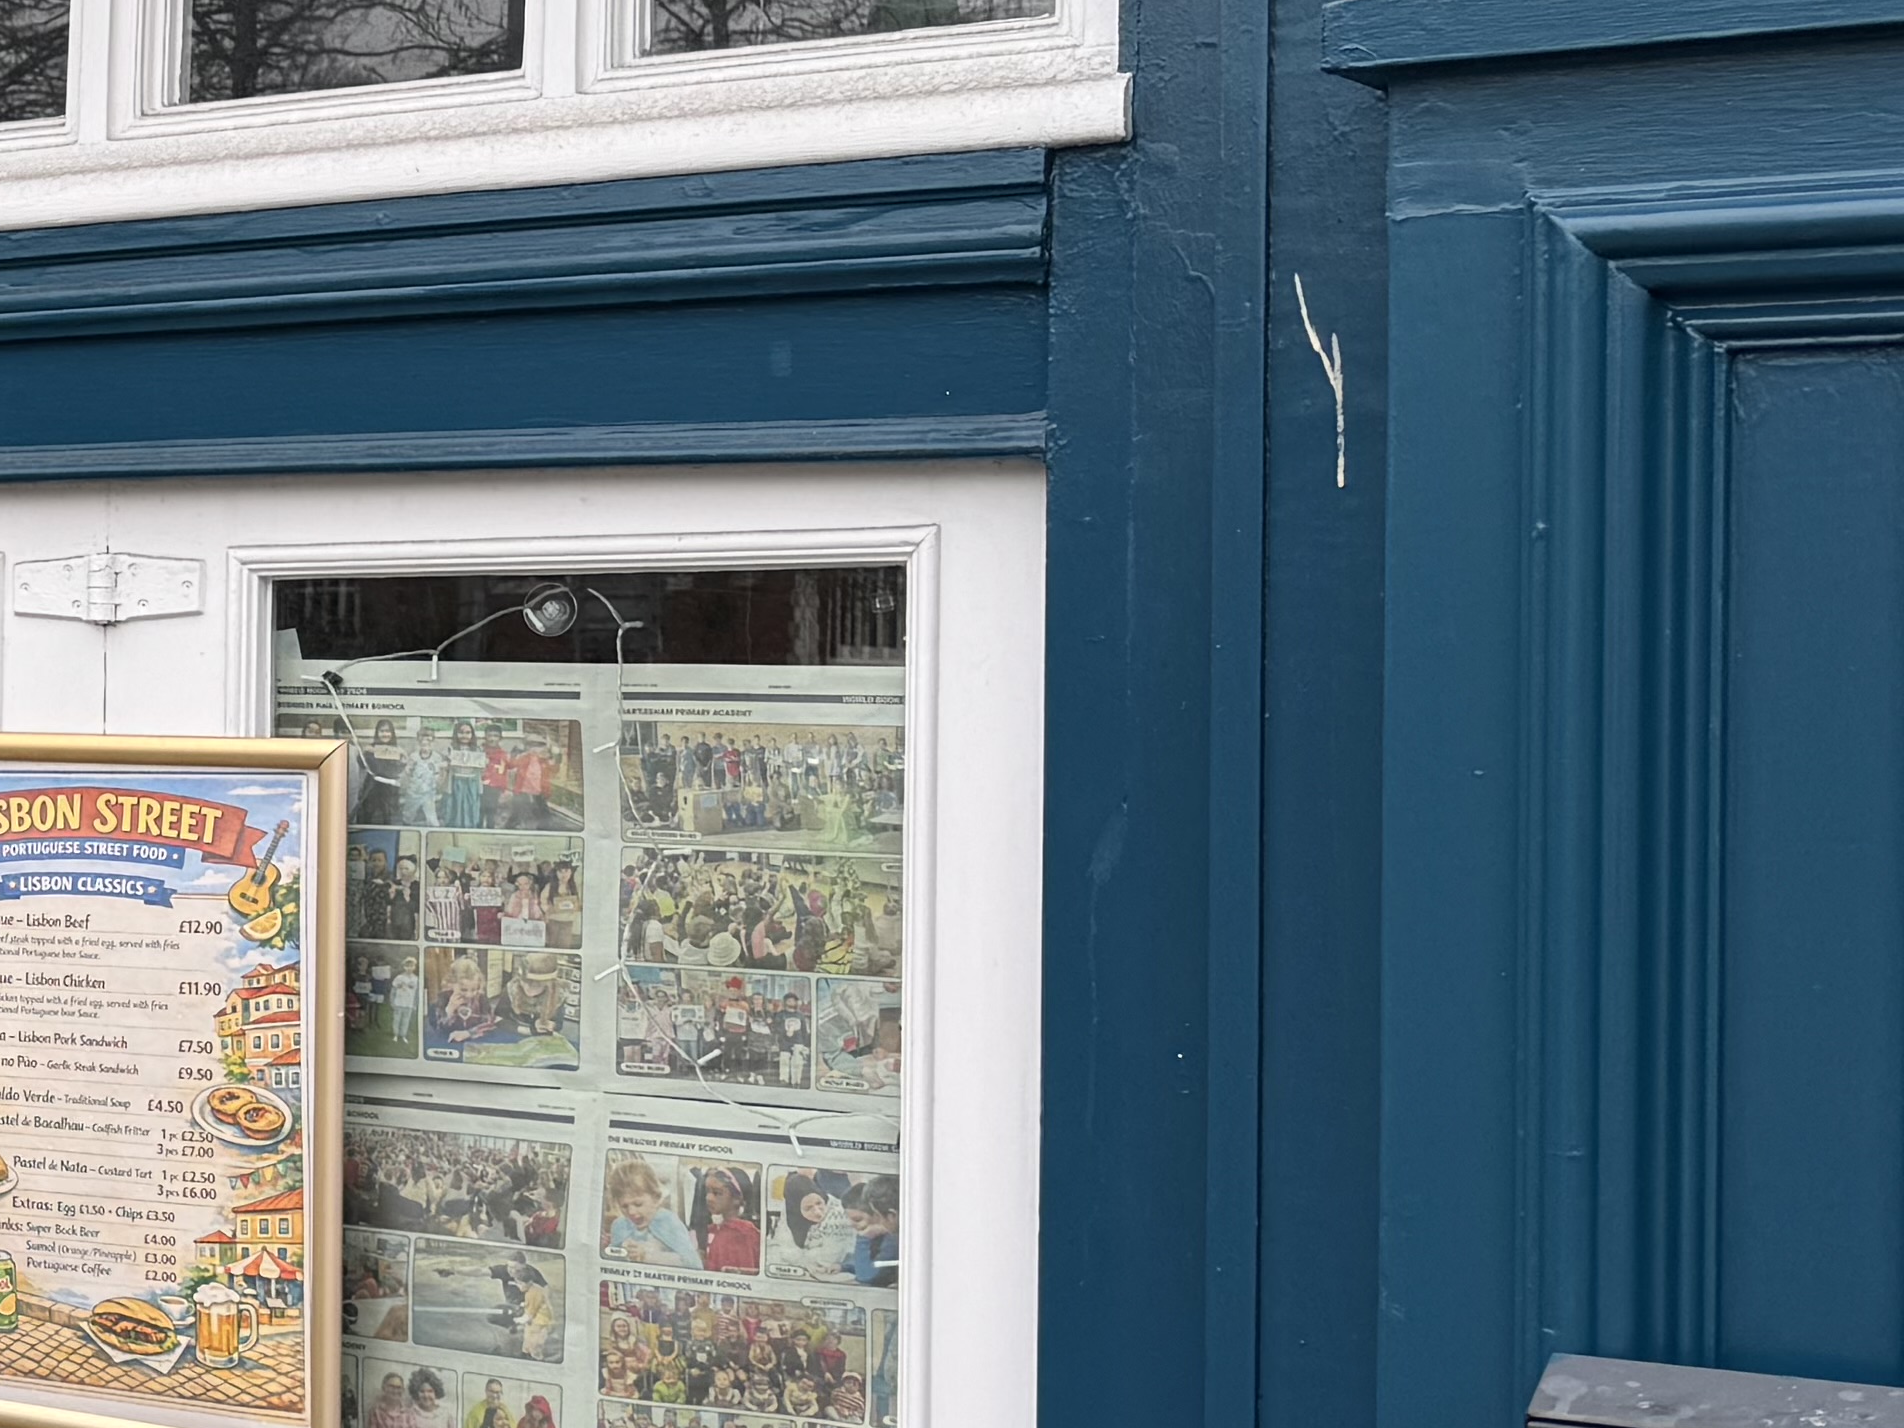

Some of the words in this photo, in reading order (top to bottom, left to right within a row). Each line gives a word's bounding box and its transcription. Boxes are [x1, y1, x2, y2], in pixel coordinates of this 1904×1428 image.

[93, 792, 223, 844] STREET
[2, 842, 81, 857] PORTUGUESE
[83, 842, 128, 858] STREET
[132, 845, 167, 861] FOOD
[20, 876, 74, 892] LISBON
[77, 878, 144, 895] CLASSICS
[26, 913, 61, 928] Lisbon
[65, 914, 90, 931] Beef
[179, 921, 223, 935] £12.90
[26, 972, 61, 987] Lisbon
[63, 974, 105, 989] Chicken
[179, 982, 221, 996] £11.90
[18, 1031, 51, 1044] Lisbon
[54, 1033, 76, 1046] Pork
[80, 1034, 128, 1049] Sandwich
[179, 1040, 213, 1054] £7.50
[1, 1057, 14, 1067] no
[47, 1059, 71, 1071] Garlic
[73, 1061, 96, 1072] Steak
[99, 1063, 139, 1076] Sandwich
[178, 1067, 213, 1081] £9.50
[23, 1089, 55, 1104] Verde
[64, 1093, 108, 1107] Traditional
[110, 1095, 131, 1110] Soup
[148, 1099, 184, 1114] £4.50
[347, 1110, 379, 1120] SCHOOL
[20, 1116, 32, 1126] de
[33, 1116, 84, 1132] Bacalhau
[92, 1122, 122, 1137] Codfish
[124, 1125, 151, 1137] Fritter
[169, 1132, 179, 1142] pc
[181, 1131, 214, 1143] £2.50
[156, 1144, 163, 1155] 3
[165, 1147, 178, 1157] pcs
[181, 1146, 214, 1158] £7.00
[13, 1156, 46, 1170] Pastel
[49, 1160, 59, 1170] de
[61, 1160, 87, 1174] Nata
[98, 1165, 132, 1178] Custard
[134, 1169, 152, 1180] Tart
[170, 1173, 179, 1183] pc
[183, 1172, 215, 1184] £2.50
[157, 1185, 163, 1196] 3
[166, 1188, 179, 1199] pcs
[182, 1187, 217, 1200] £6.00
[12, 1196, 53, 1212] Extras:
[57, 1200, 76, 1216] Egg
[79, 1204, 105, 1217] £1.50
[115, 1206, 143, 1221] Chips
[146, 1209, 175, 1222] £3.50
[26, 1222, 51, 1237] Super
[54, 1224, 78, 1237] Bock
[79, 1226, 100, 1238] Beer
[144, 1234, 176, 1247] £4.00
[25, 1240, 56, 1254] Sumol
[58, 1244, 137, 1264] (Orange/Pineapple)
[145, 1252, 176, 1266] £3.00
[27, 1257, 79, 1273] Portuguese
[81, 1261, 112, 1277] Coffee
[145, 1270, 177, 1283] £2.00
